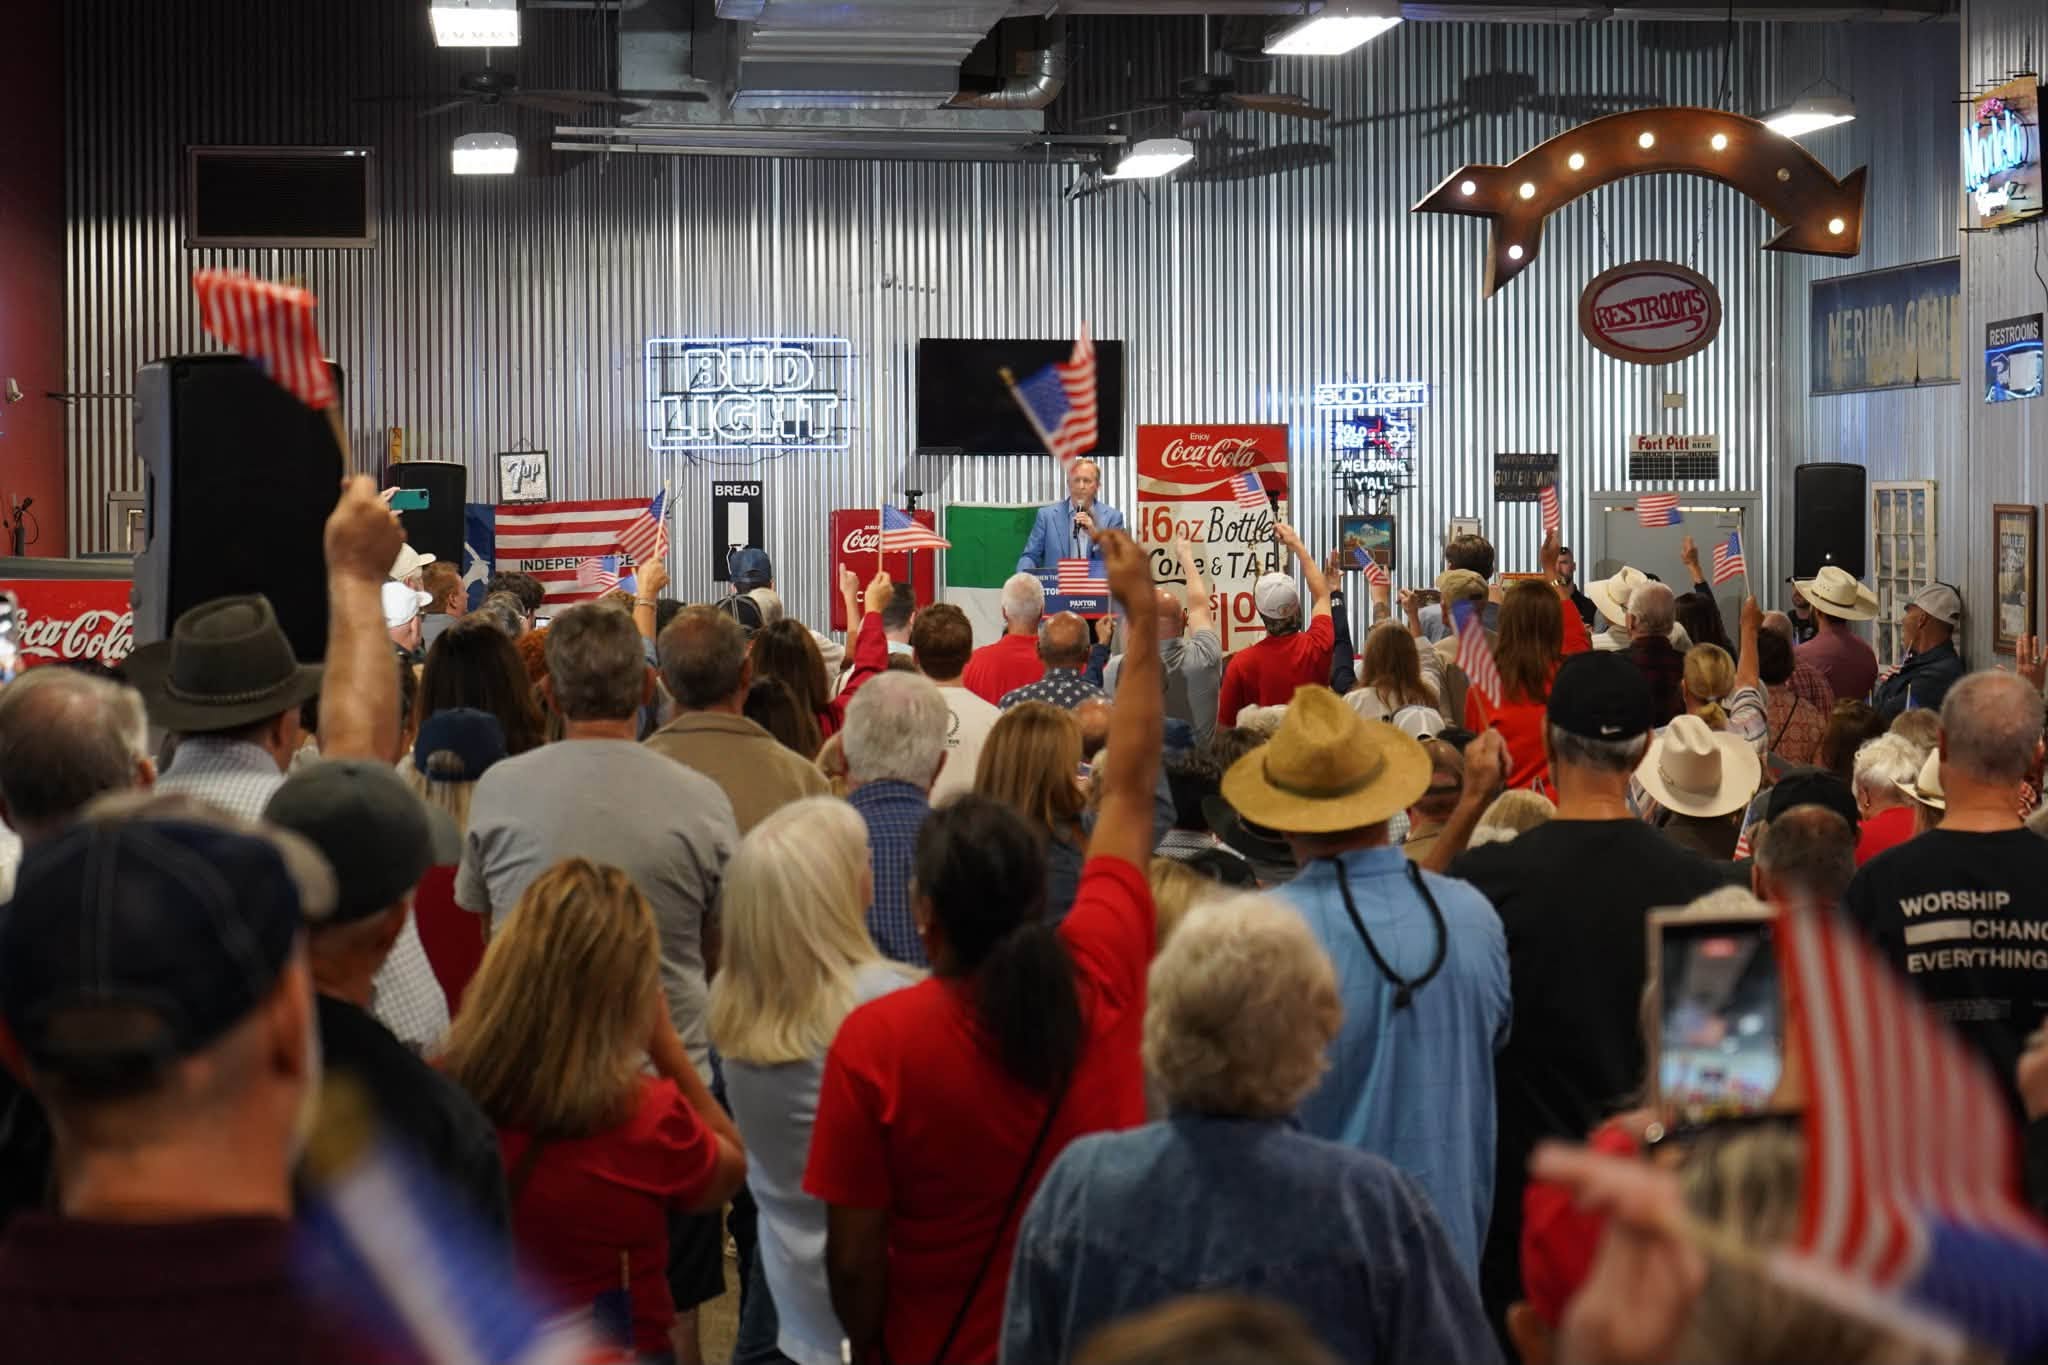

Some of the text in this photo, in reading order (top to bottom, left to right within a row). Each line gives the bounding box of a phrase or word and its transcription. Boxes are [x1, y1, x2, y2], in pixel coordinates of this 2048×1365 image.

[1964, 109, 2021, 191] Modelo
[1595, 289, 1706, 330] RESTROOMS
[1828, 303, 1894, 360] MERINO
[1990, 322, 2040, 346] RESTROOMS
[685, 348, 814, 393] BUD
[661, 394, 838, 440] LIGHT
[1190, 432, 1210, 441] Enjoy
[1637, 436, 1663, 450] Fort
[1666, 436, 1689, 450] Pitt
[1161, 438, 1259, 468] Coca-Cola
[1340, 459, 1407, 472] WELCOME
[715, 485, 760, 496] BREAD
[1354, 478, 1394, 490] Y'ALL
[1208, 505, 1279, 543] Bottle
[1070, 600, 1097, 608] PAXTON
[1900, 891, 2011, 917] WORSHIP
[1906, 947, 2048, 973] EVERYTHING
